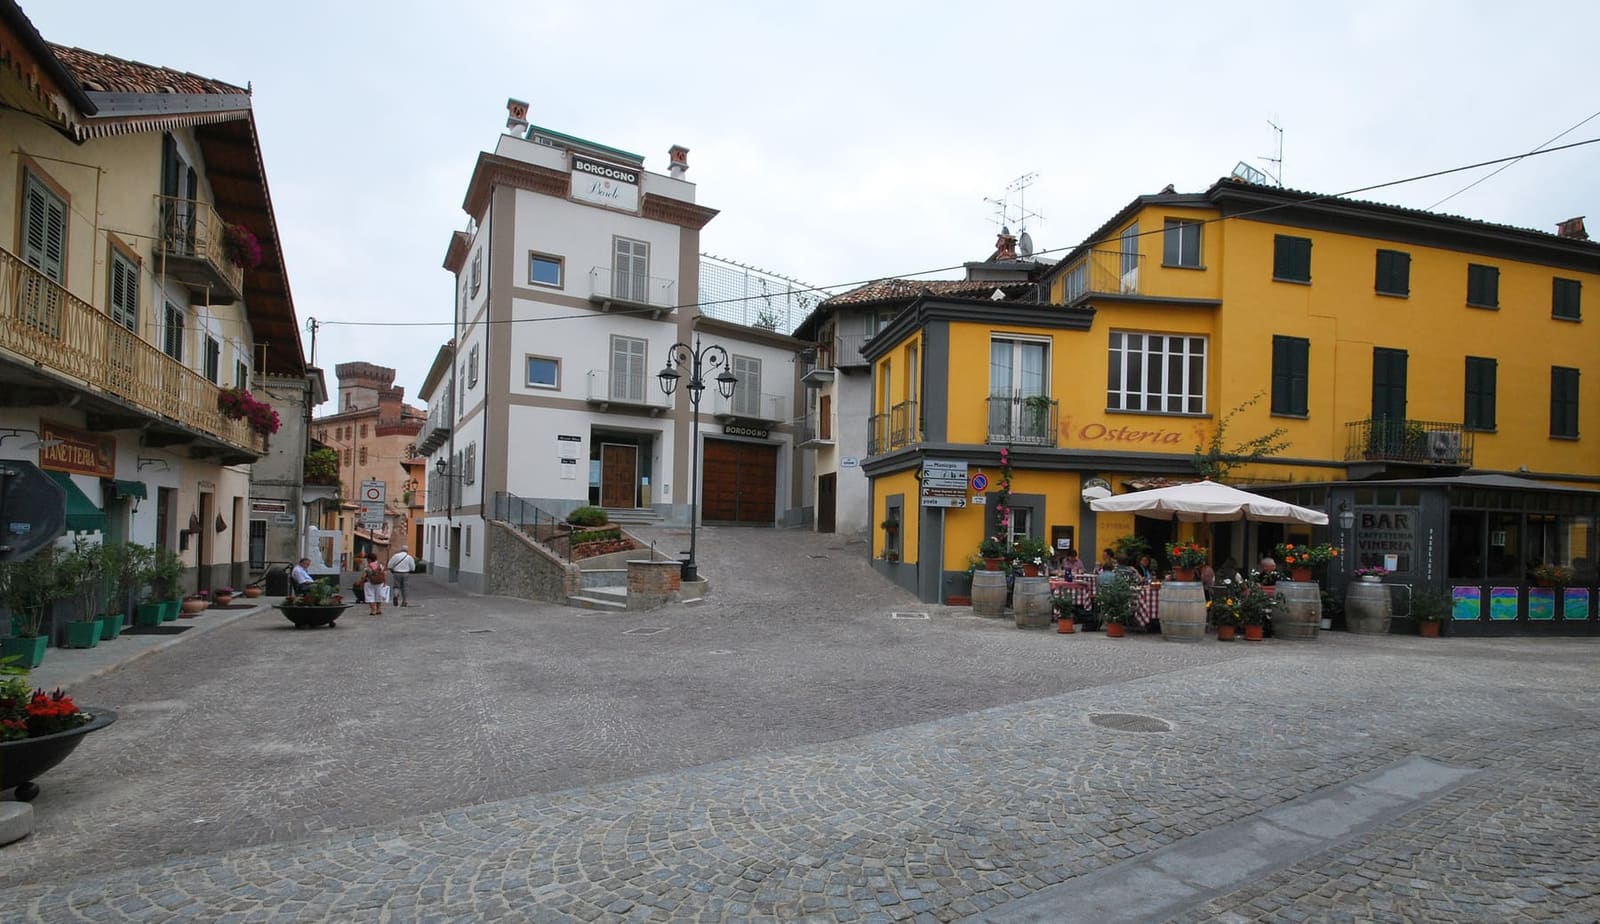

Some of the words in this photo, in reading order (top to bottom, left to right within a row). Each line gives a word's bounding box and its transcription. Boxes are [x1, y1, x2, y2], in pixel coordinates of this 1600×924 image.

[575, 160, 635, 183] BORGOGNO
[725, 426, 767, 438] BORGOGNO
[1079, 423, 1183, 444] Osteria
[45, 431, 96, 466] PANETTERIA
[1362, 513, 1408, 529] BAR
[1359, 532, 1413, 540] CAFFETTERIA
[1359, 540, 1412, 551] VINERIA
